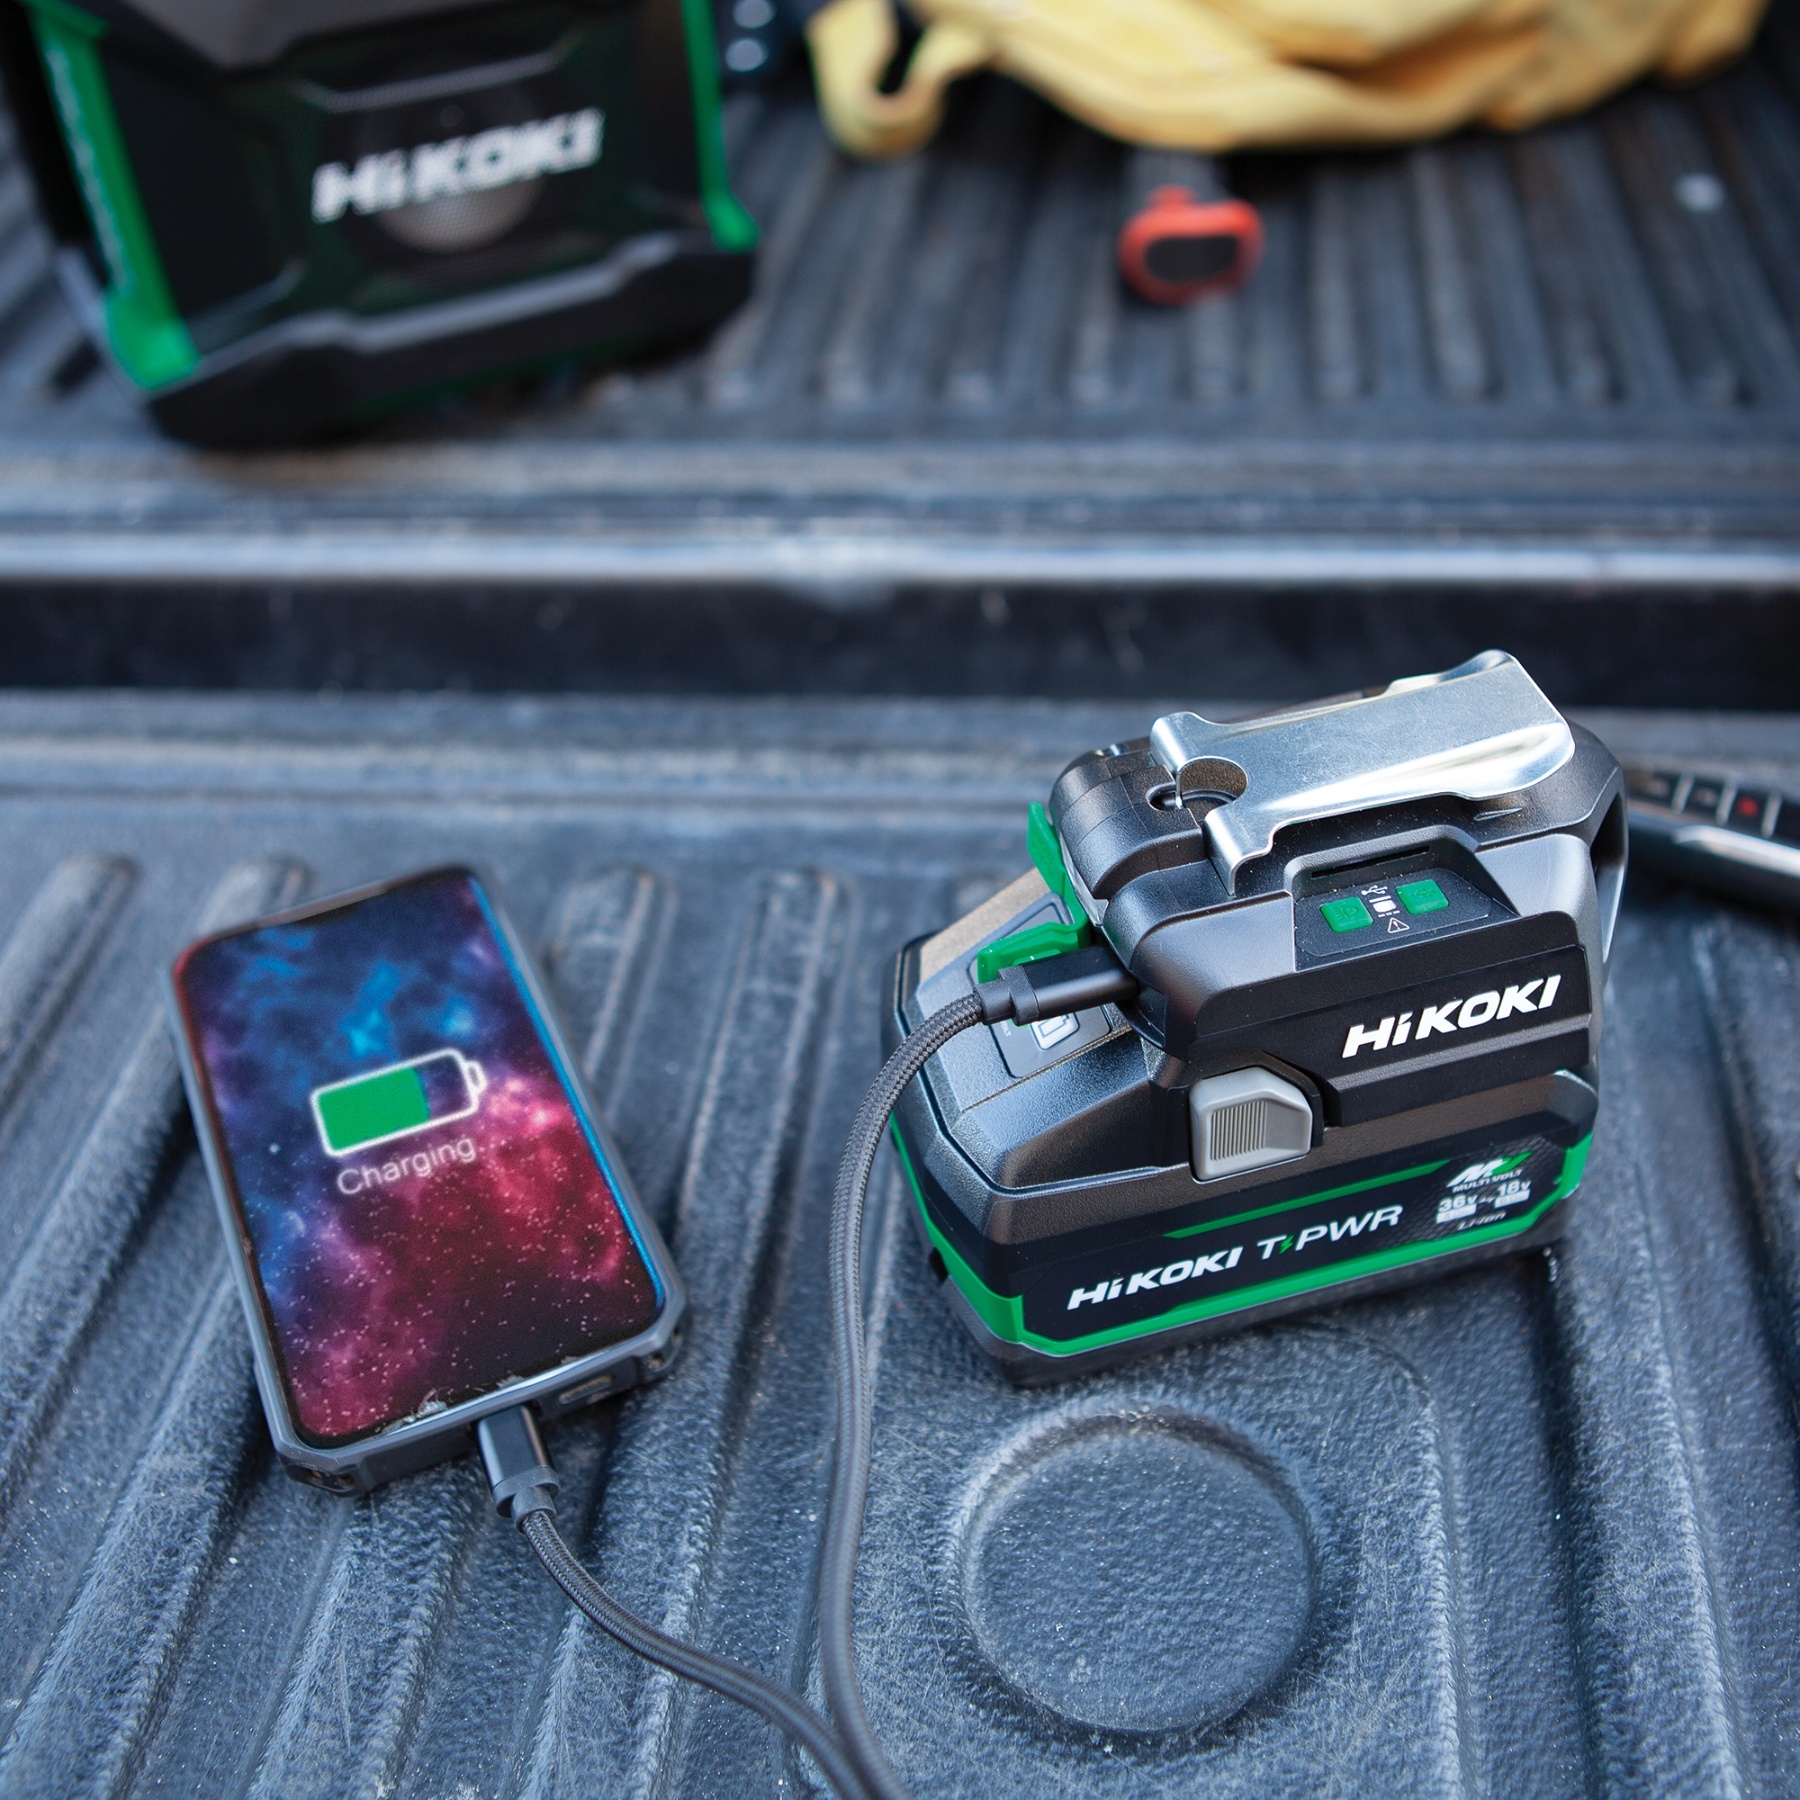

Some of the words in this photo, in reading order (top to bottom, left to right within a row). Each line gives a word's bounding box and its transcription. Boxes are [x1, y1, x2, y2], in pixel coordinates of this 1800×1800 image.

[1342, 974, 1562, 1058] HiKOKI
[336, 1138, 477, 1195] Charging
[1452, 1174, 1491, 1194] MULTI
[1491, 1168, 1524, 1184] VOLT
[1067, 1246, 1243, 1311] HiKOKI
